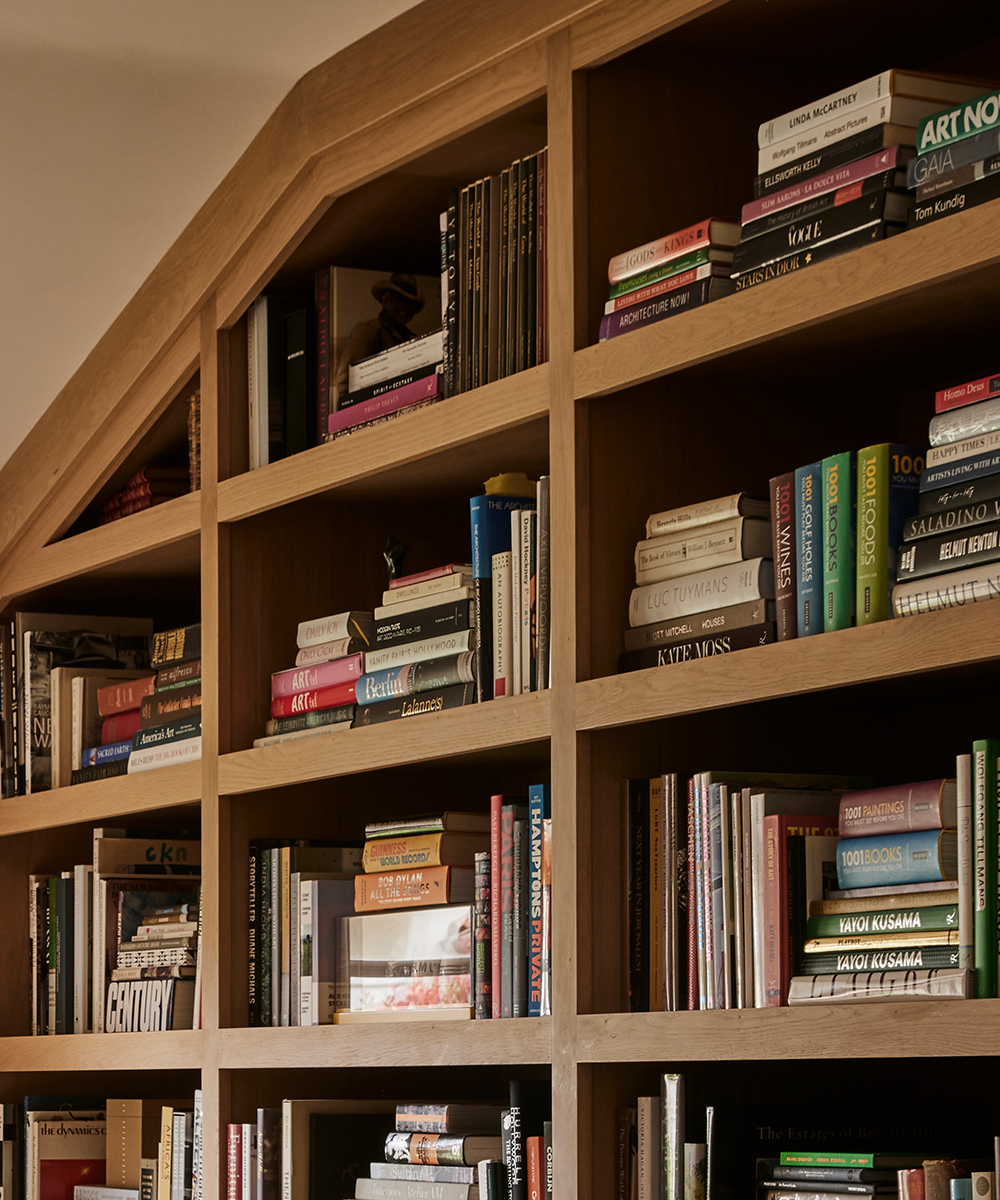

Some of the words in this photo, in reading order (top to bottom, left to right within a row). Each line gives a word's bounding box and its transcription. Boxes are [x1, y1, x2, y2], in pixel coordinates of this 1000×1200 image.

[790, 113, 810, 128] LINDA
[813, 92, 858, 118] McCARTNEY
[921, 109, 961, 149] ART
[964, 94, 1000, 133] NO
[824, 126, 845, 139] Abstract
[846, 116, 868, 130] Pictures
[772, 142, 795, 160] Wolfgang
[765, 165, 801, 188] ELLSWORTH
[803, 156, 822, 171] KELLY
[914, 149, 954, 182] GAIA
[762, 199, 775, 210] SLIM
[777, 190, 801, 205] AARONS
[805, 185, 813, 193] LA
[814, 177, 834, 190] DOLCE
[836, 170, 850, 181] VITA
[915, 206, 932, 221] Tom
[935, 193, 965, 214] Kundig
[788, 220, 822, 247] VOGUE
[630, 246, 654, 266] GODS
[664, 231, 693, 253] KINGS
[448, 251, 456, 279] TO
[736, 271, 764, 291] STARS
[766, 264, 774, 280] IN
[777, 256, 800, 275] DIOR
[619, 299, 668, 327] ARCHITECTURE
[670, 292, 689, 308] NOW!
[944, 390, 965, 401] Homo
[967, 382, 984, 394] Deus
[933, 446, 958, 460] HAPPY
[962, 438, 984, 452] TIMES
[829, 464, 838, 504] 1001
[866, 457, 876, 496] 1001
[780, 483, 790, 523] 1001
[864, 499, 876, 565] FOODS
[911, 504, 987, 536] SALADINO
[829, 506, 838, 571] BOOKS
[940, 539, 968, 560] HELMUT
[968, 531, 998, 554] NEWTON
[780, 526, 790, 587] WINES
[497, 573, 502, 587] AN
[648, 589, 669, 609] LUC
[673, 576, 728, 603] TUYMANS
[539, 565, 548, 652] VERVOORDT
[897, 581, 977, 617] HELMUT
[702, 616, 725, 629] HOUSES
[369, 654, 389, 666] VANITY
[414, 639, 456, 656] HOLLYWOOD
[658, 644, 691, 667] KATE
[695, 636, 730, 658] MOSS
[169, 666, 192, 681] alfresco
[366, 673, 403, 700] Berlin
[401, 696, 443, 716] Lalanne(s)
[140, 728, 164, 744] America's
[165, 728, 174, 738] Art
[98, 746, 113, 758] SACRED
[114, 745, 129, 754] EARTH
[845, 806, 861, 820] 1001
[862, 800, 904, 816] PAINTINGS
[370, 842, 407, 857] GUINNESS
[380, 856, 400, 866] WORLD
[501, 812, 514, 912] PARIS
[531, 809, 541, 918] HAMPTONS
[842, 850, 864, 867] 1001
[864, 846, 902, 865] BOOKS
[378, 876, 393, 887] BOB
[396, 873, 422, 886] DYLAN
[977, 838, 985, 907] TILLMANS
[370, 889, 383, 900] ALL
[386, 887, 400, 898] THE
[403, 883, 430, 896] SONGS
[636, 893, 642, 905] IN
[840, 917, 869, 934] YAYOI
[872, 912, 921, 931] KUSAMA
[531, 920, 540, 1002] PRIVATE
[837, 954, 868, 971] YAYOI
[871, 951, 923, 968] KUSAMA
[106, 980, 173, 1033] CENTURY
[756, 1126, 782, 1140] The
[788, 1126, 834, 1140] Estates
[840, 1124, 854, 1140] of
[859, 1126, 907, 1142] Beverly
[911, 1124, 944, 1139] Hills
